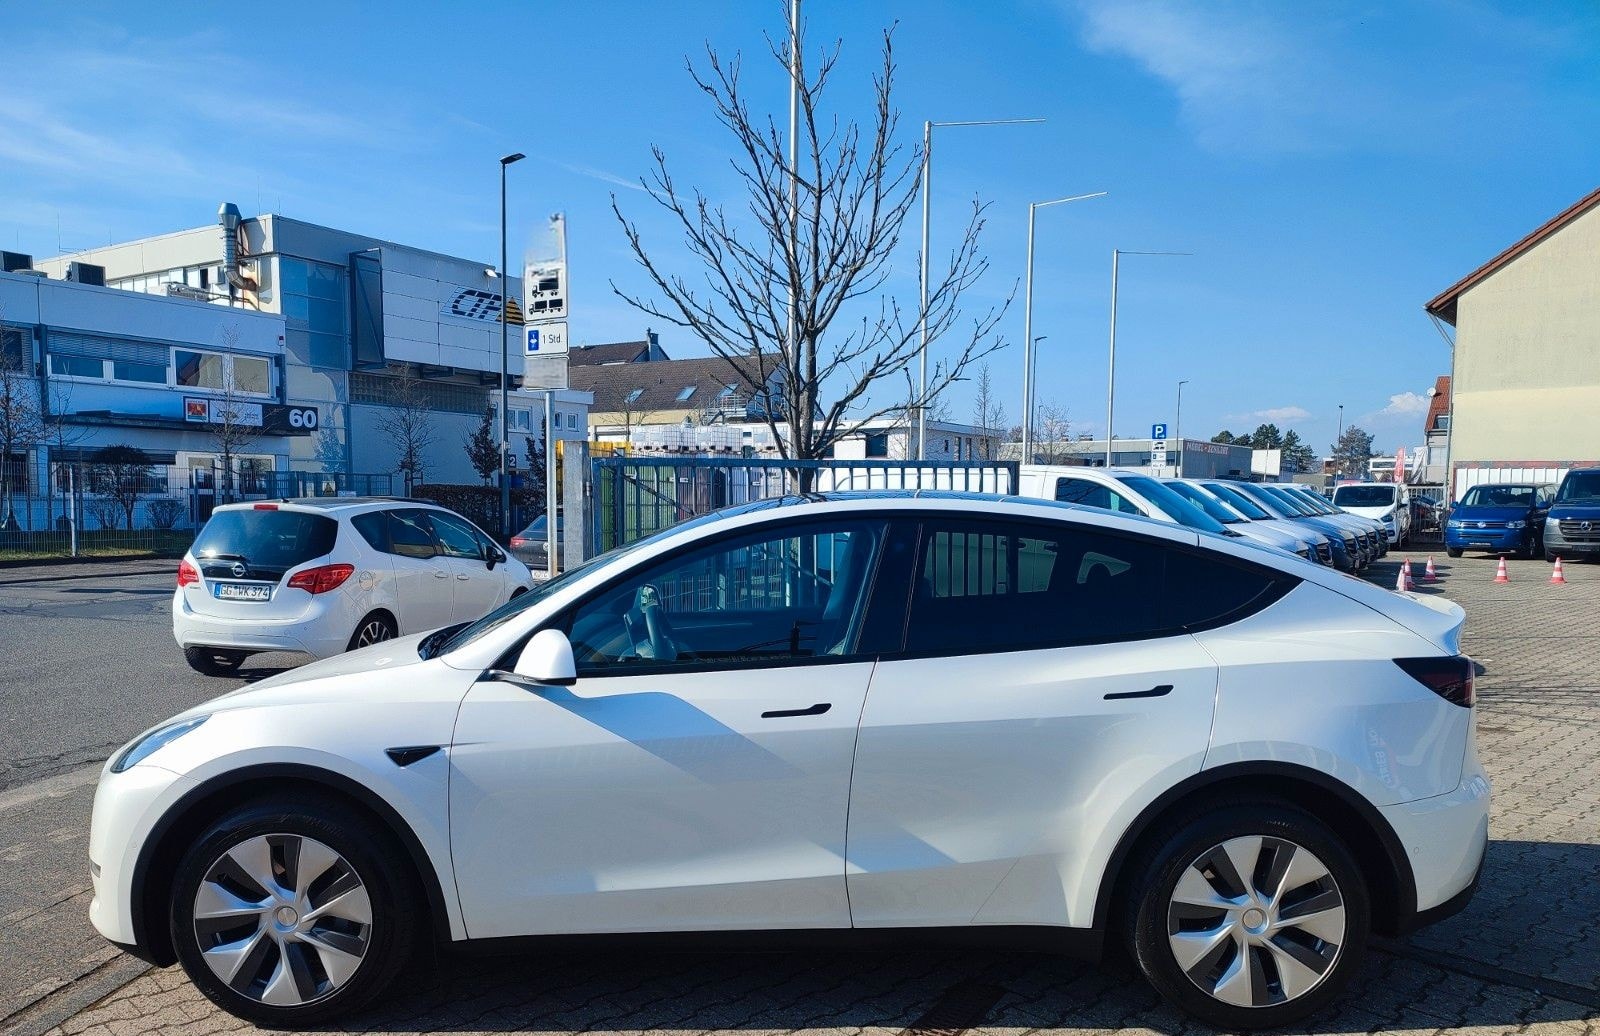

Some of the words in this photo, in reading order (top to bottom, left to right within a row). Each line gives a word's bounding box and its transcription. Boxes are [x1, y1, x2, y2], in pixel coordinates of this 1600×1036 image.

[542, 334, 546, 344] 1
[289, 409, 316, 428] 60
[1155, 425, 1164, 438] P
[251, 586, 269, 597] 374
